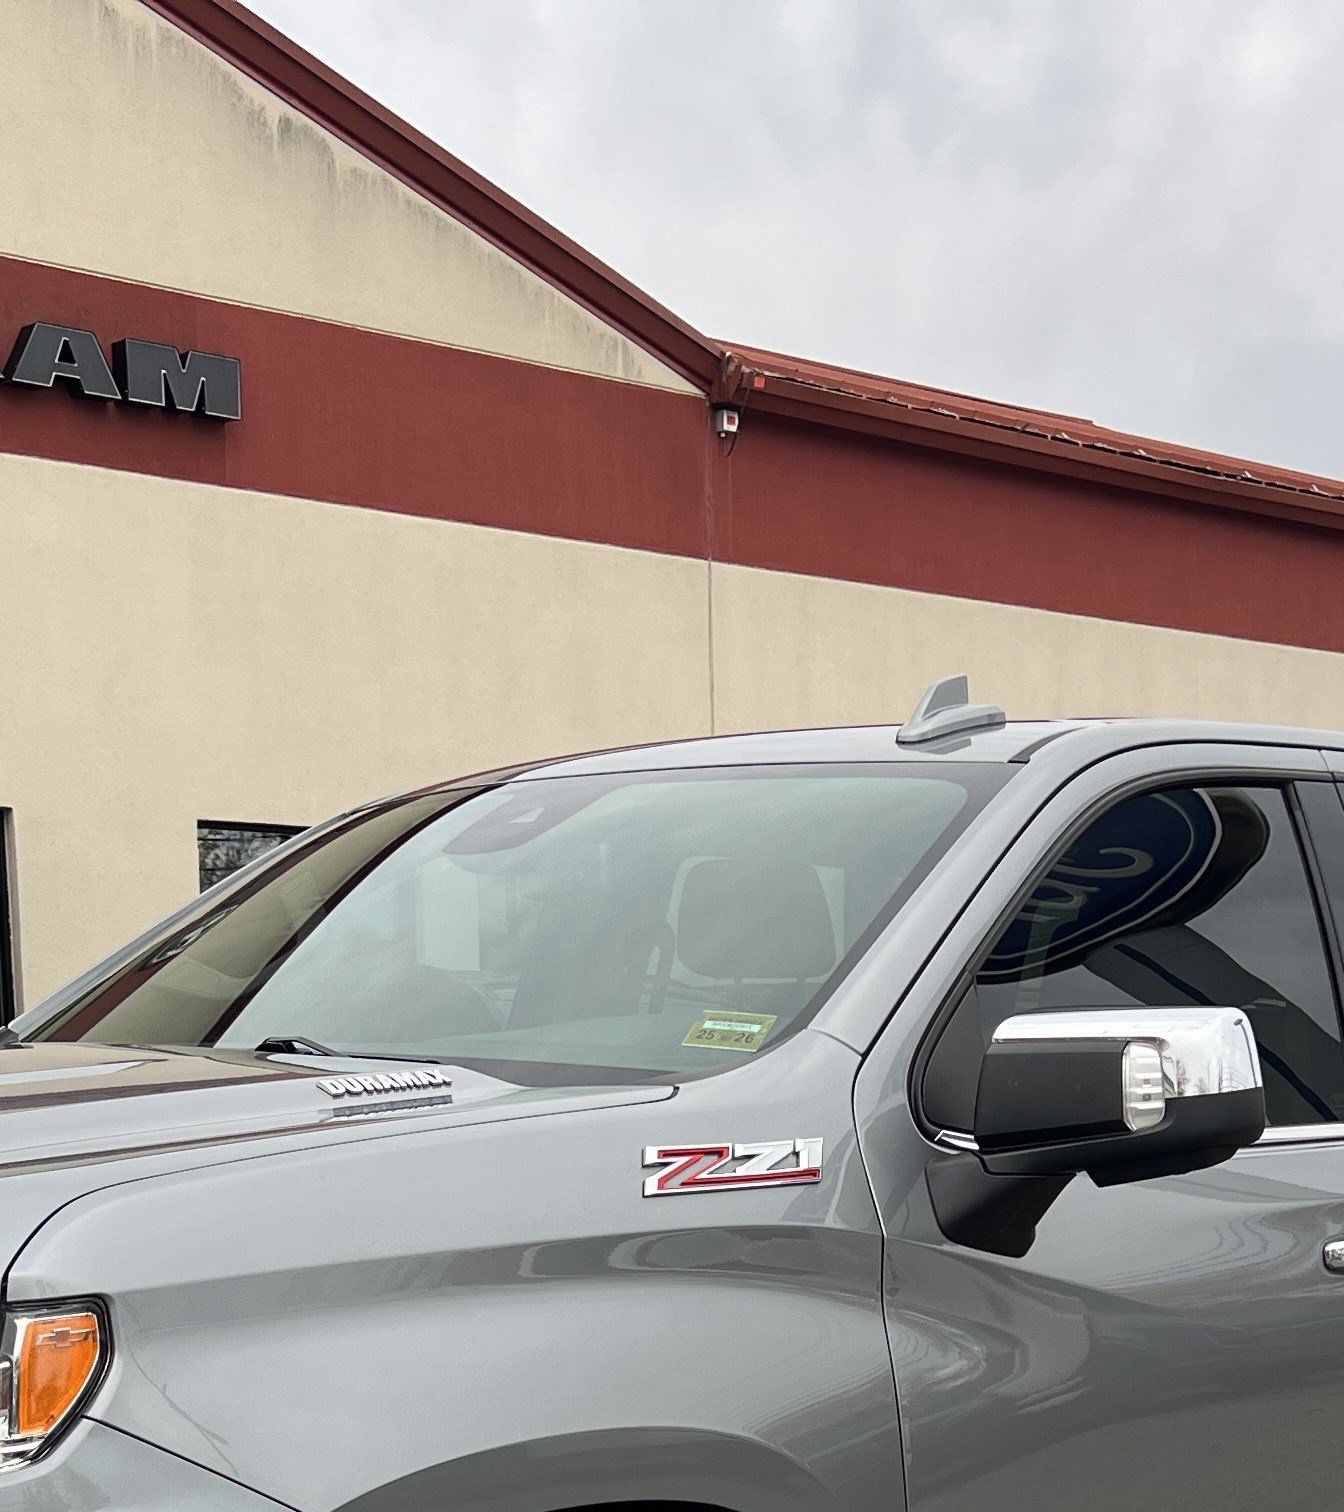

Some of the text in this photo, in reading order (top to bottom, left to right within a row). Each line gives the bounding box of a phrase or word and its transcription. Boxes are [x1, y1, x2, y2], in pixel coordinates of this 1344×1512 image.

[696, 1029, 756, 1043] 25 26
[317, 1069, 453, 1100] DURAMAX
[642, 1137, 824, 1198] Z71
